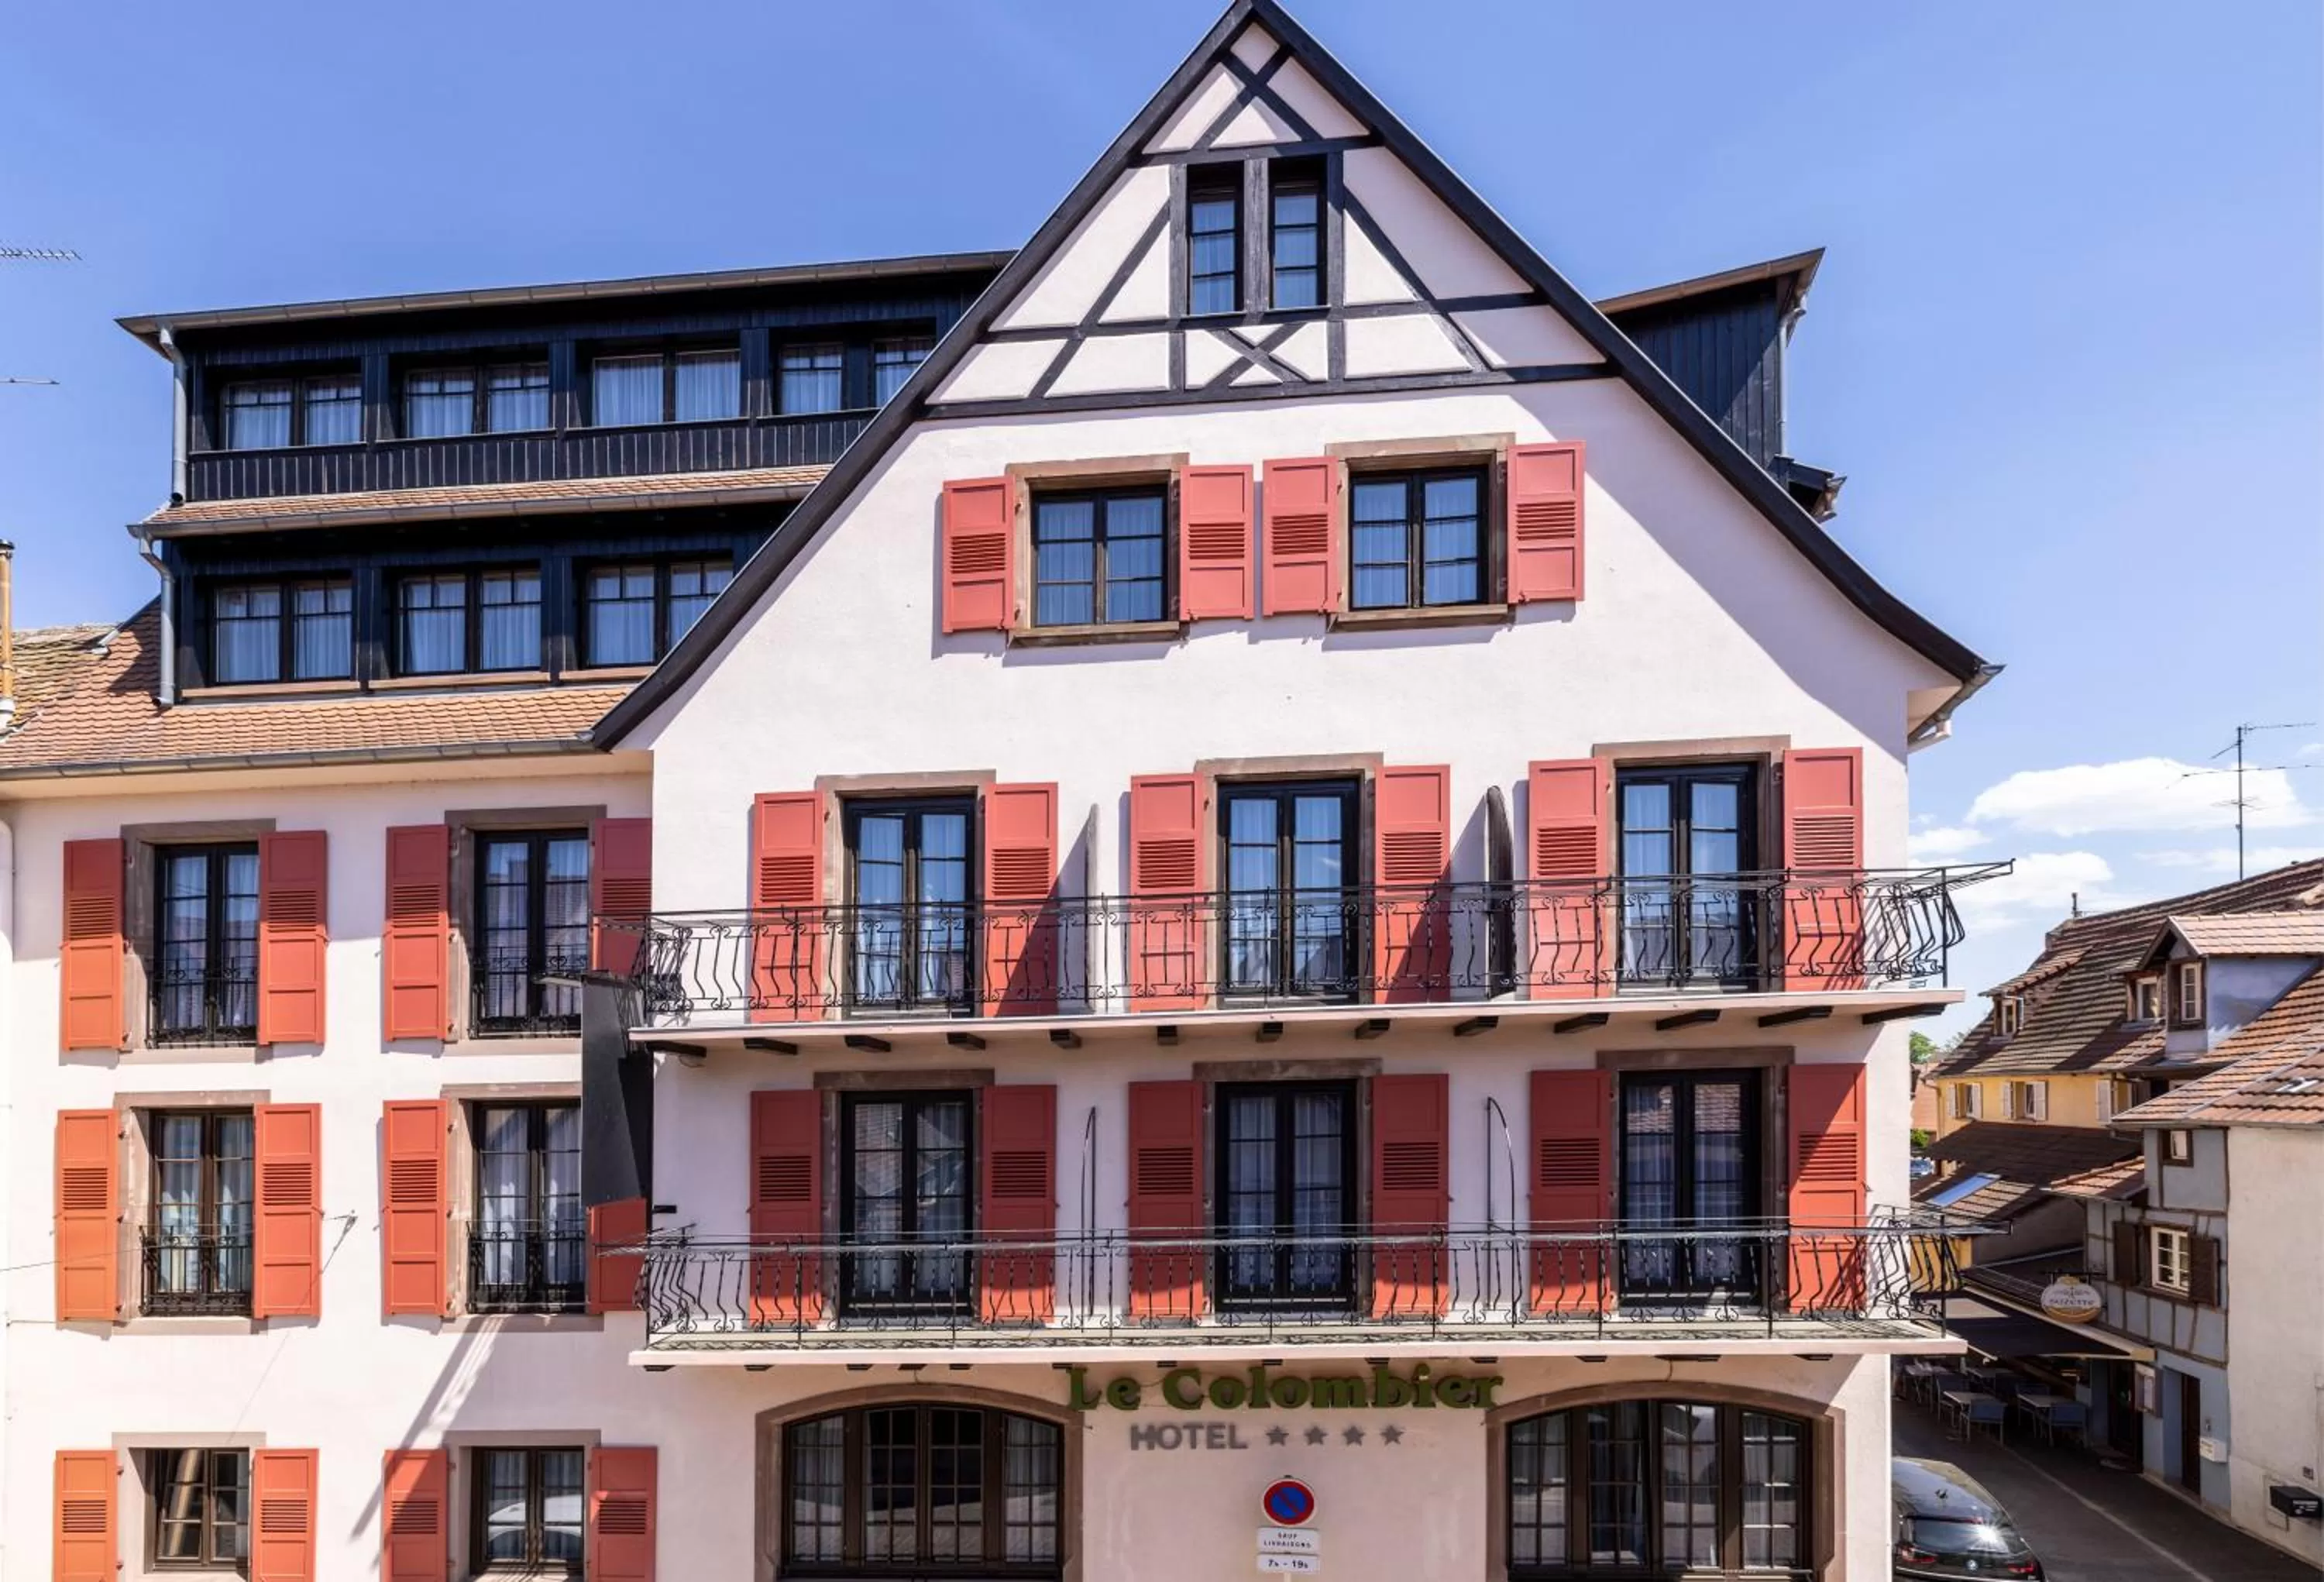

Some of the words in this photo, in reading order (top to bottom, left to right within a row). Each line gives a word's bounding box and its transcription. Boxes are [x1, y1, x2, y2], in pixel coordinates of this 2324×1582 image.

[1067, 1367, 1141, 1411] Le
[1163, 1362, 1504, 1411] Colombier
[1129, 1422, 1249, 1451] HOTEL
[1263, 1540, 1312, 1549] LIVRAISONS
